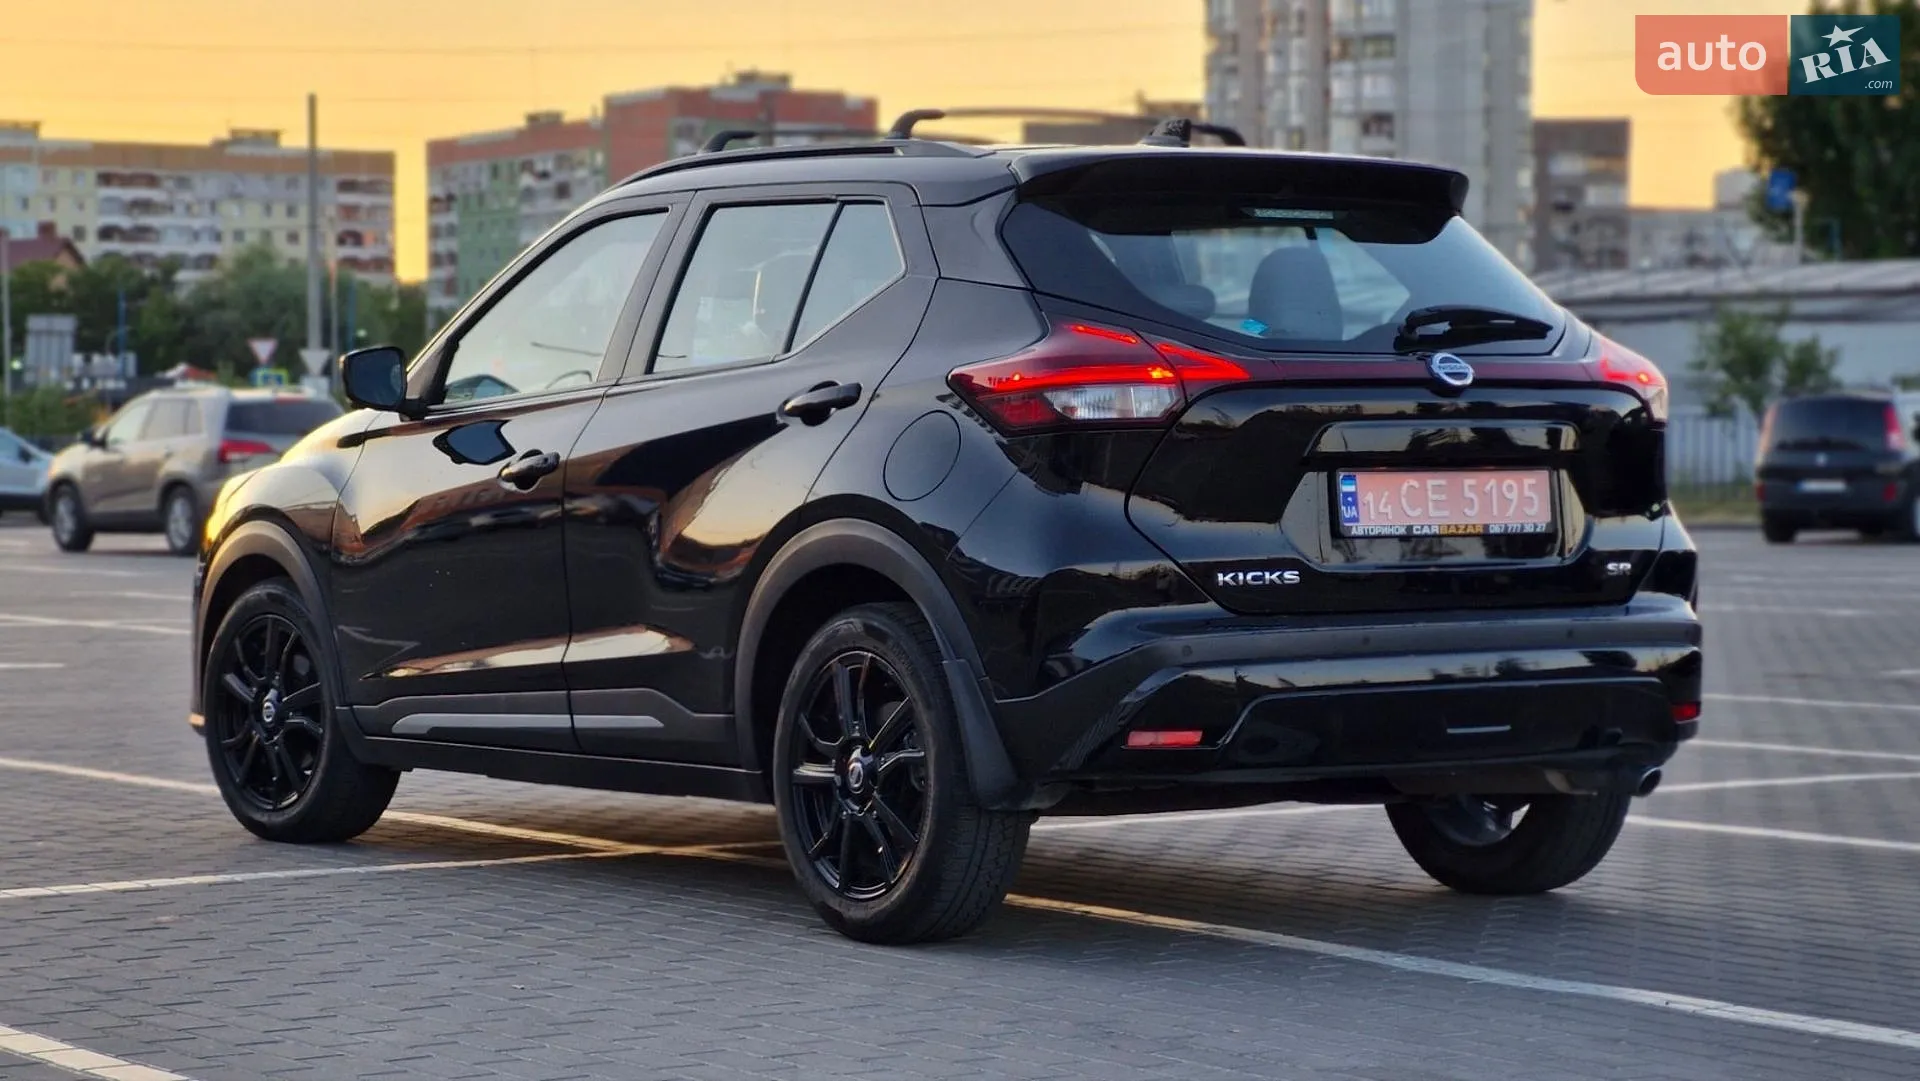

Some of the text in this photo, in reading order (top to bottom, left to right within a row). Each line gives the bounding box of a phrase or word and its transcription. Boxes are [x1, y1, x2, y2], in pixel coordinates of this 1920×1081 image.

[1363, 477, 1540, 520] 14 CE 5195
[1343, 506, 1358, 519] UA
[1351, 525, 1407, 536] АВТОРИНОК
[1606, 562, 1632, 576] SR
[1217, 570, 1300, 586] KICKS
